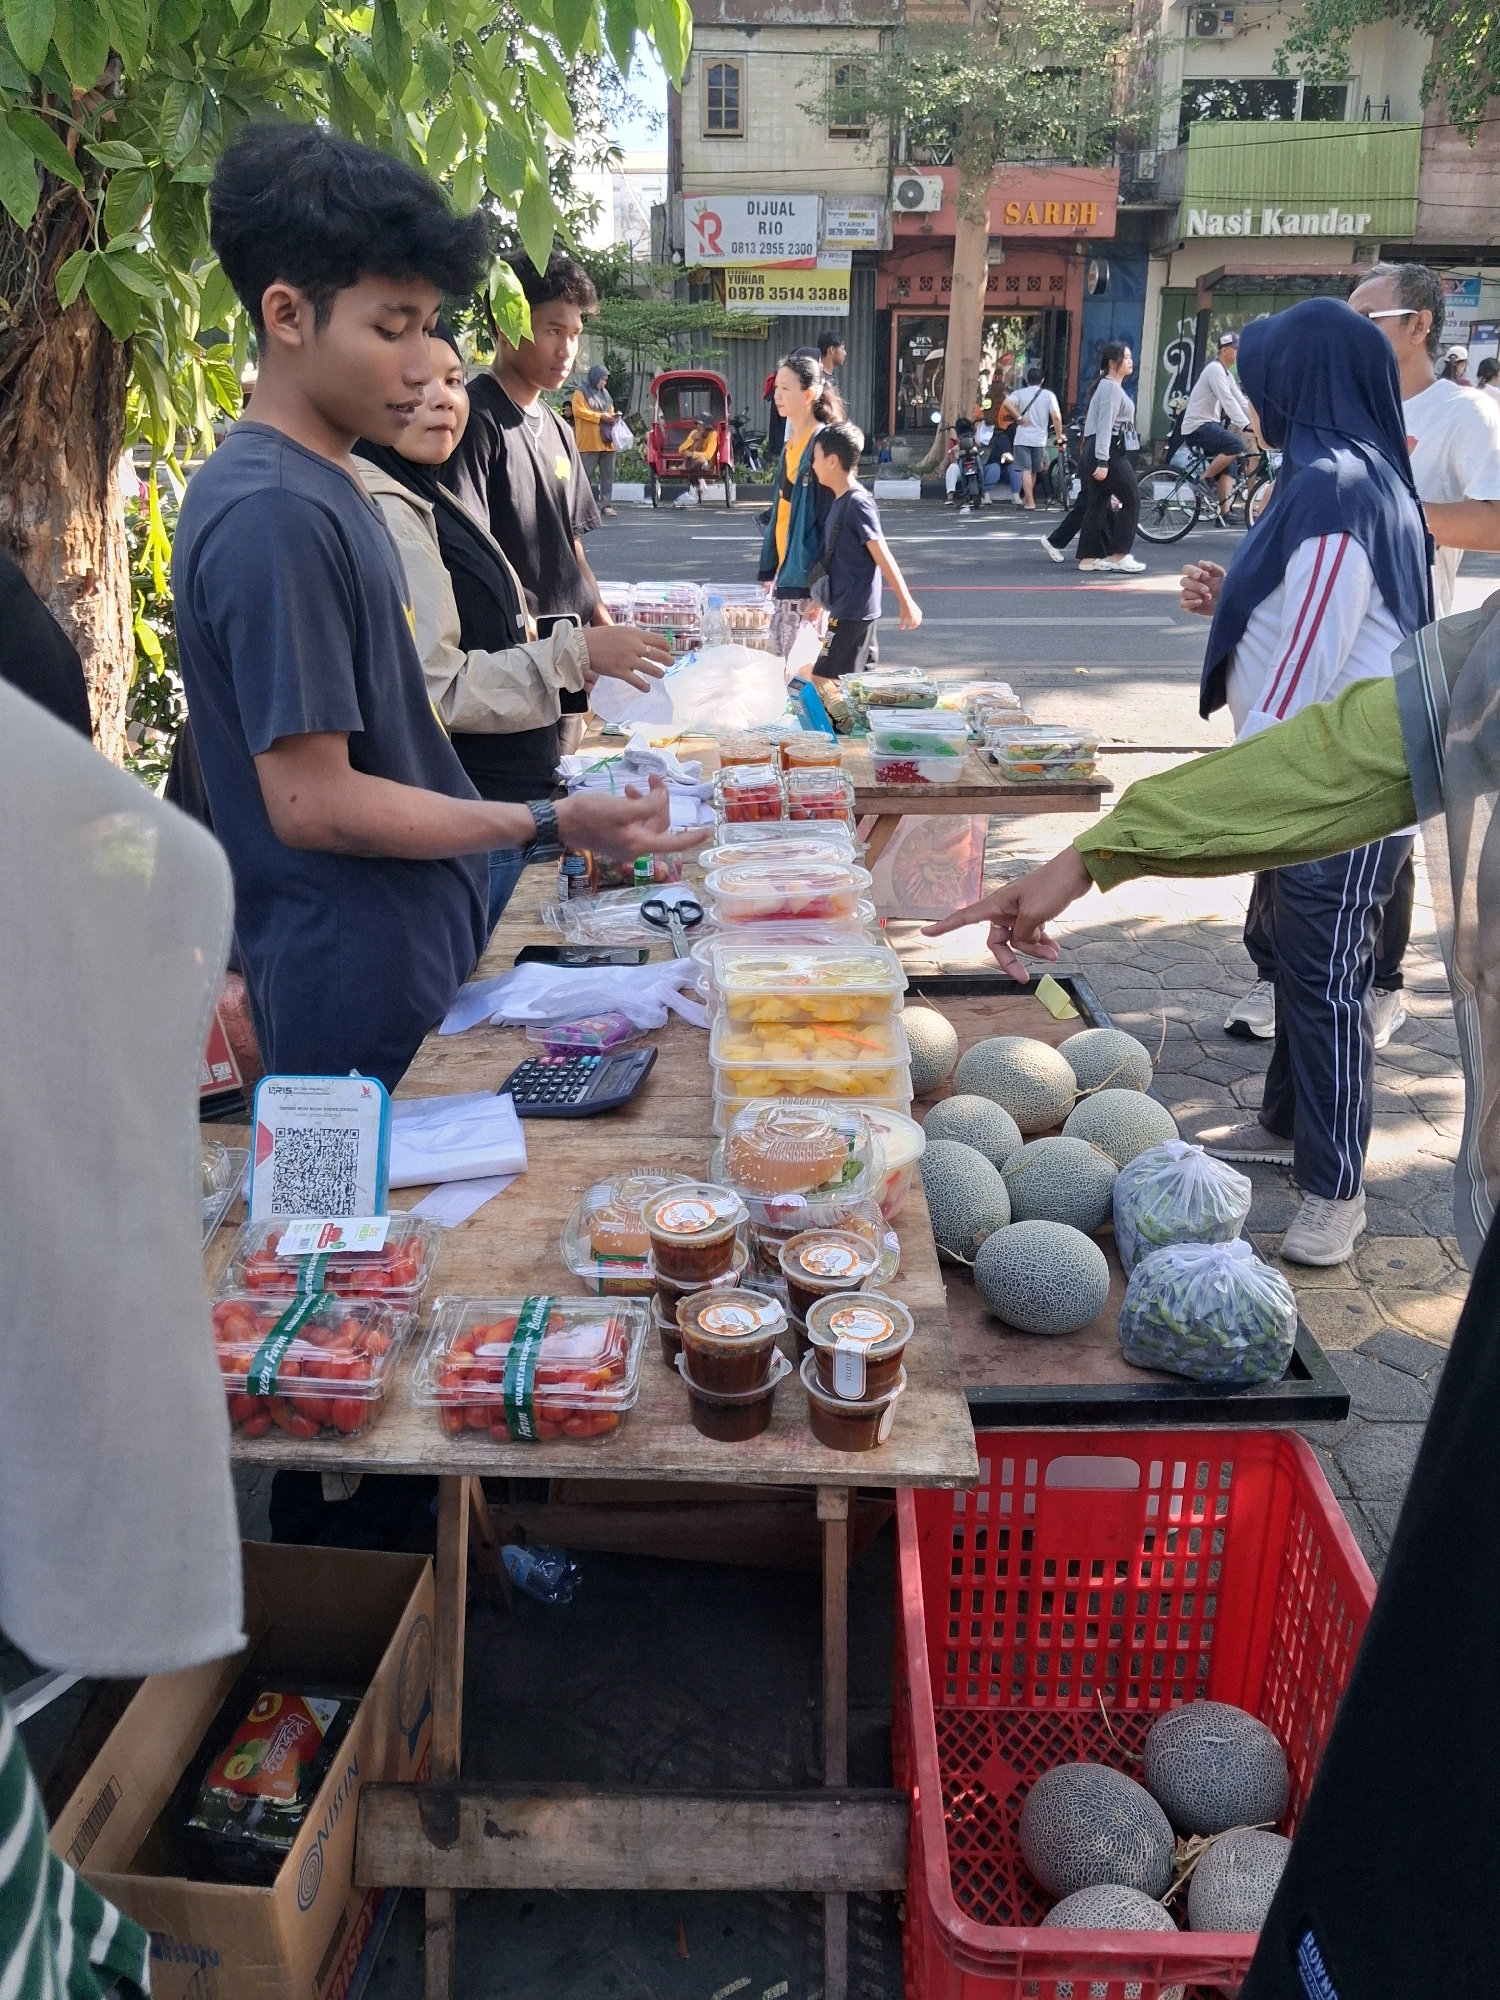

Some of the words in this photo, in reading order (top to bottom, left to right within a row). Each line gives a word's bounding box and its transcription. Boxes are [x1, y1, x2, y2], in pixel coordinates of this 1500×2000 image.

[747, 201, 796, 216] DIJUAL
[1004, 201, 1098, 226] SAREH
[758, 221, 783, 235] RIO
[1187, 208, 1250, 236] Nasi
[1261, 207, 1371, 236] Kandar
[731, 242, 756, 254] 0813
[759, 242, 784, 255] 2955
[788, 243, 813, 255] 2300
[727, 275, 765, 285] YUNIAR
[728, 286, 765, 301] 0878
[769, 287, 804, 301] 3514
[809, 287, 848, 301] 3388
[268, 1086, 293, 1096] QRIS
[264, 1336, 289, 1364] Farm
[515, 1361, 527, 1406] KUALITAS
[517, 1412, 533, 1438] Farm
[316, 1752, 360, 1856] NISSIN
